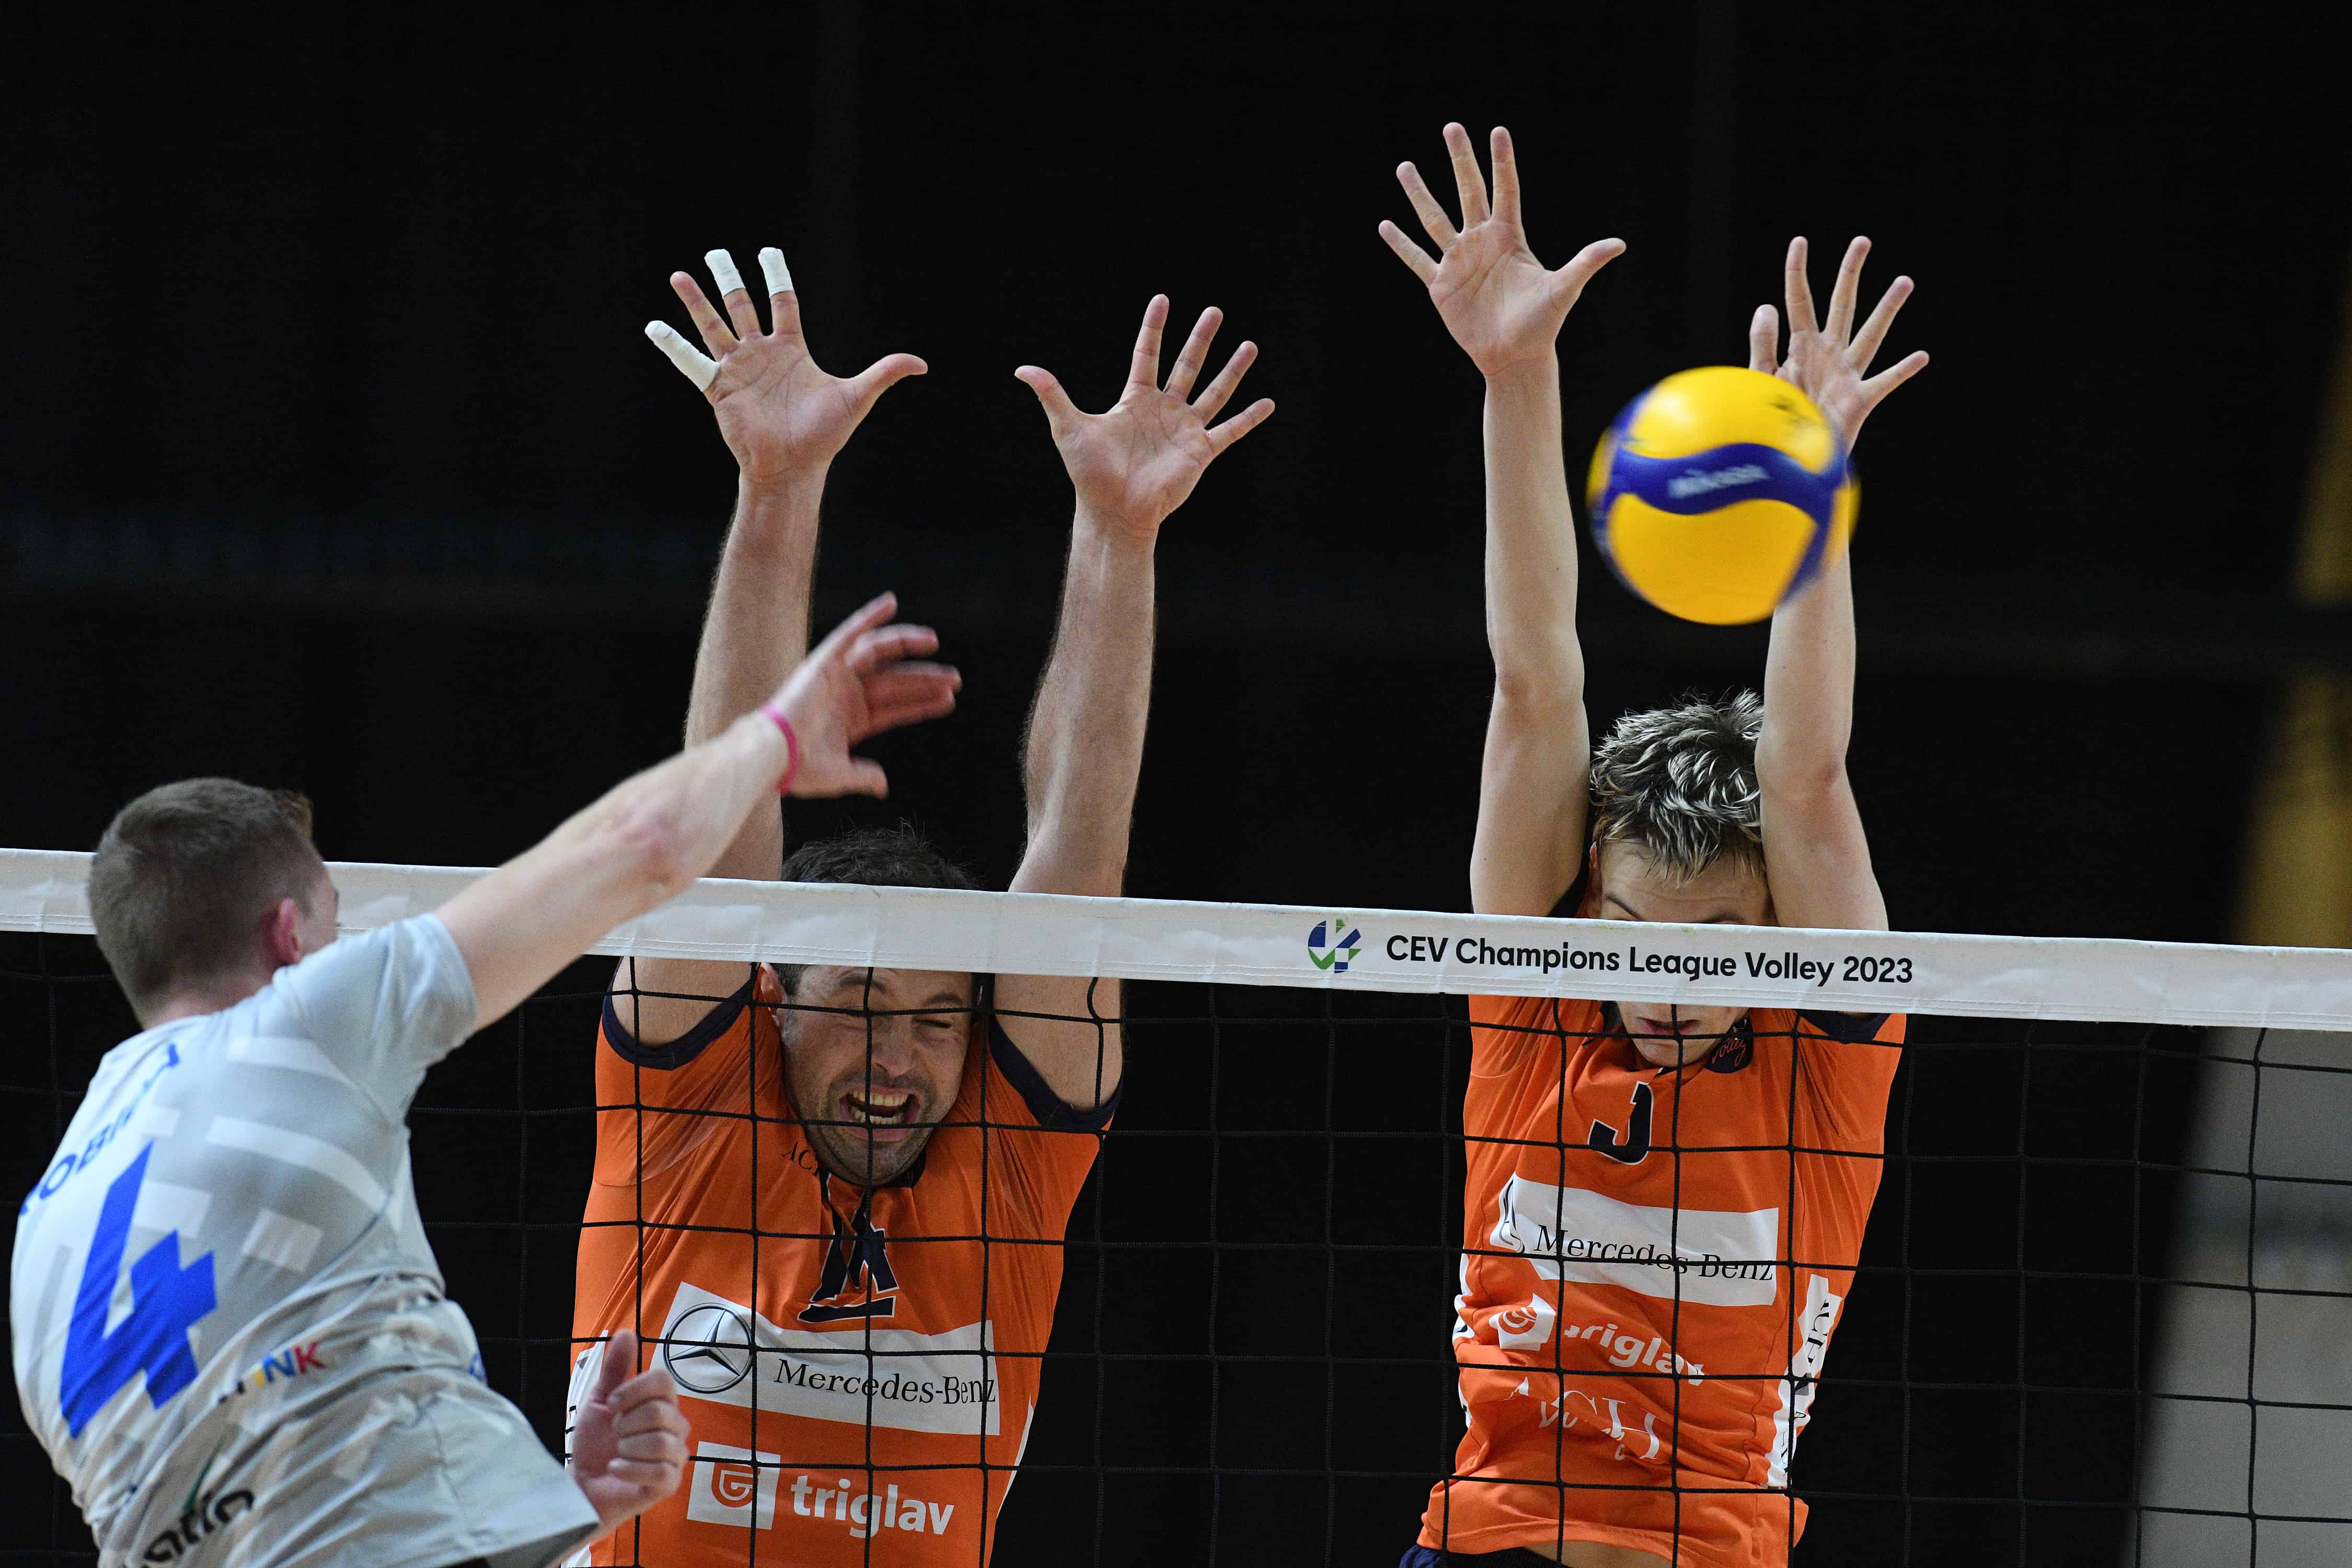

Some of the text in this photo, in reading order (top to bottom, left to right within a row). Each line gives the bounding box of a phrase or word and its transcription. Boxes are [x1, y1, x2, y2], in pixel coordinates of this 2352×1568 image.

[1387, 935, 1913, 987] CEV Champions League Volley 2023
[781, 1141, 820, 1177] AC
[1534, 1224, 1773, 1281] MercedesBenz
[61, 1139, 216, 1439] 4
[773, 1358, 996, 1404] Mercedes-Benz
[790, 1475, 955, 1539] triglav
